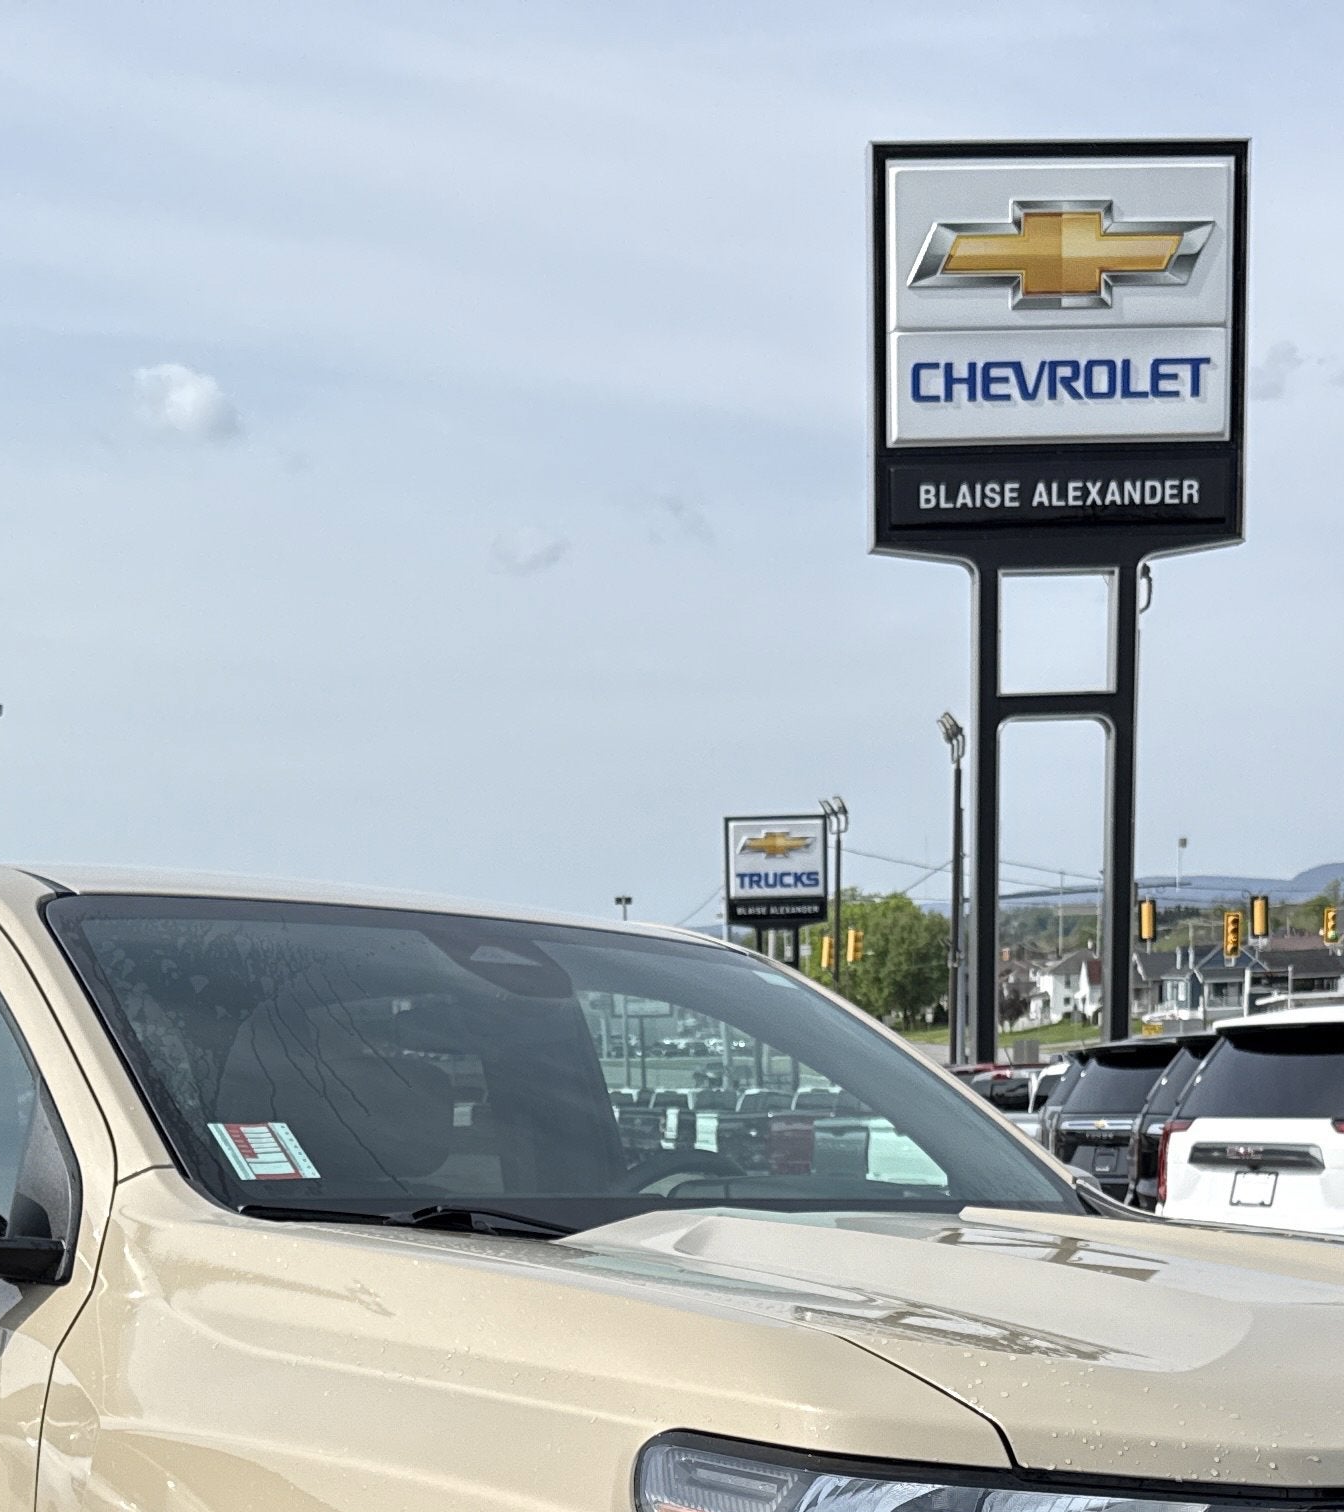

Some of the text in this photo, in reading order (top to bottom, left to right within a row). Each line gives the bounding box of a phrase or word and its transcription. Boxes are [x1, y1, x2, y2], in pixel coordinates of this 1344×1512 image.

[911, 357, 1211, 403] CHEVROLET
[918, 478, 1200, 509] BLAISE ALEXANDER
[736, 871, 820, 889] TRUCKS
